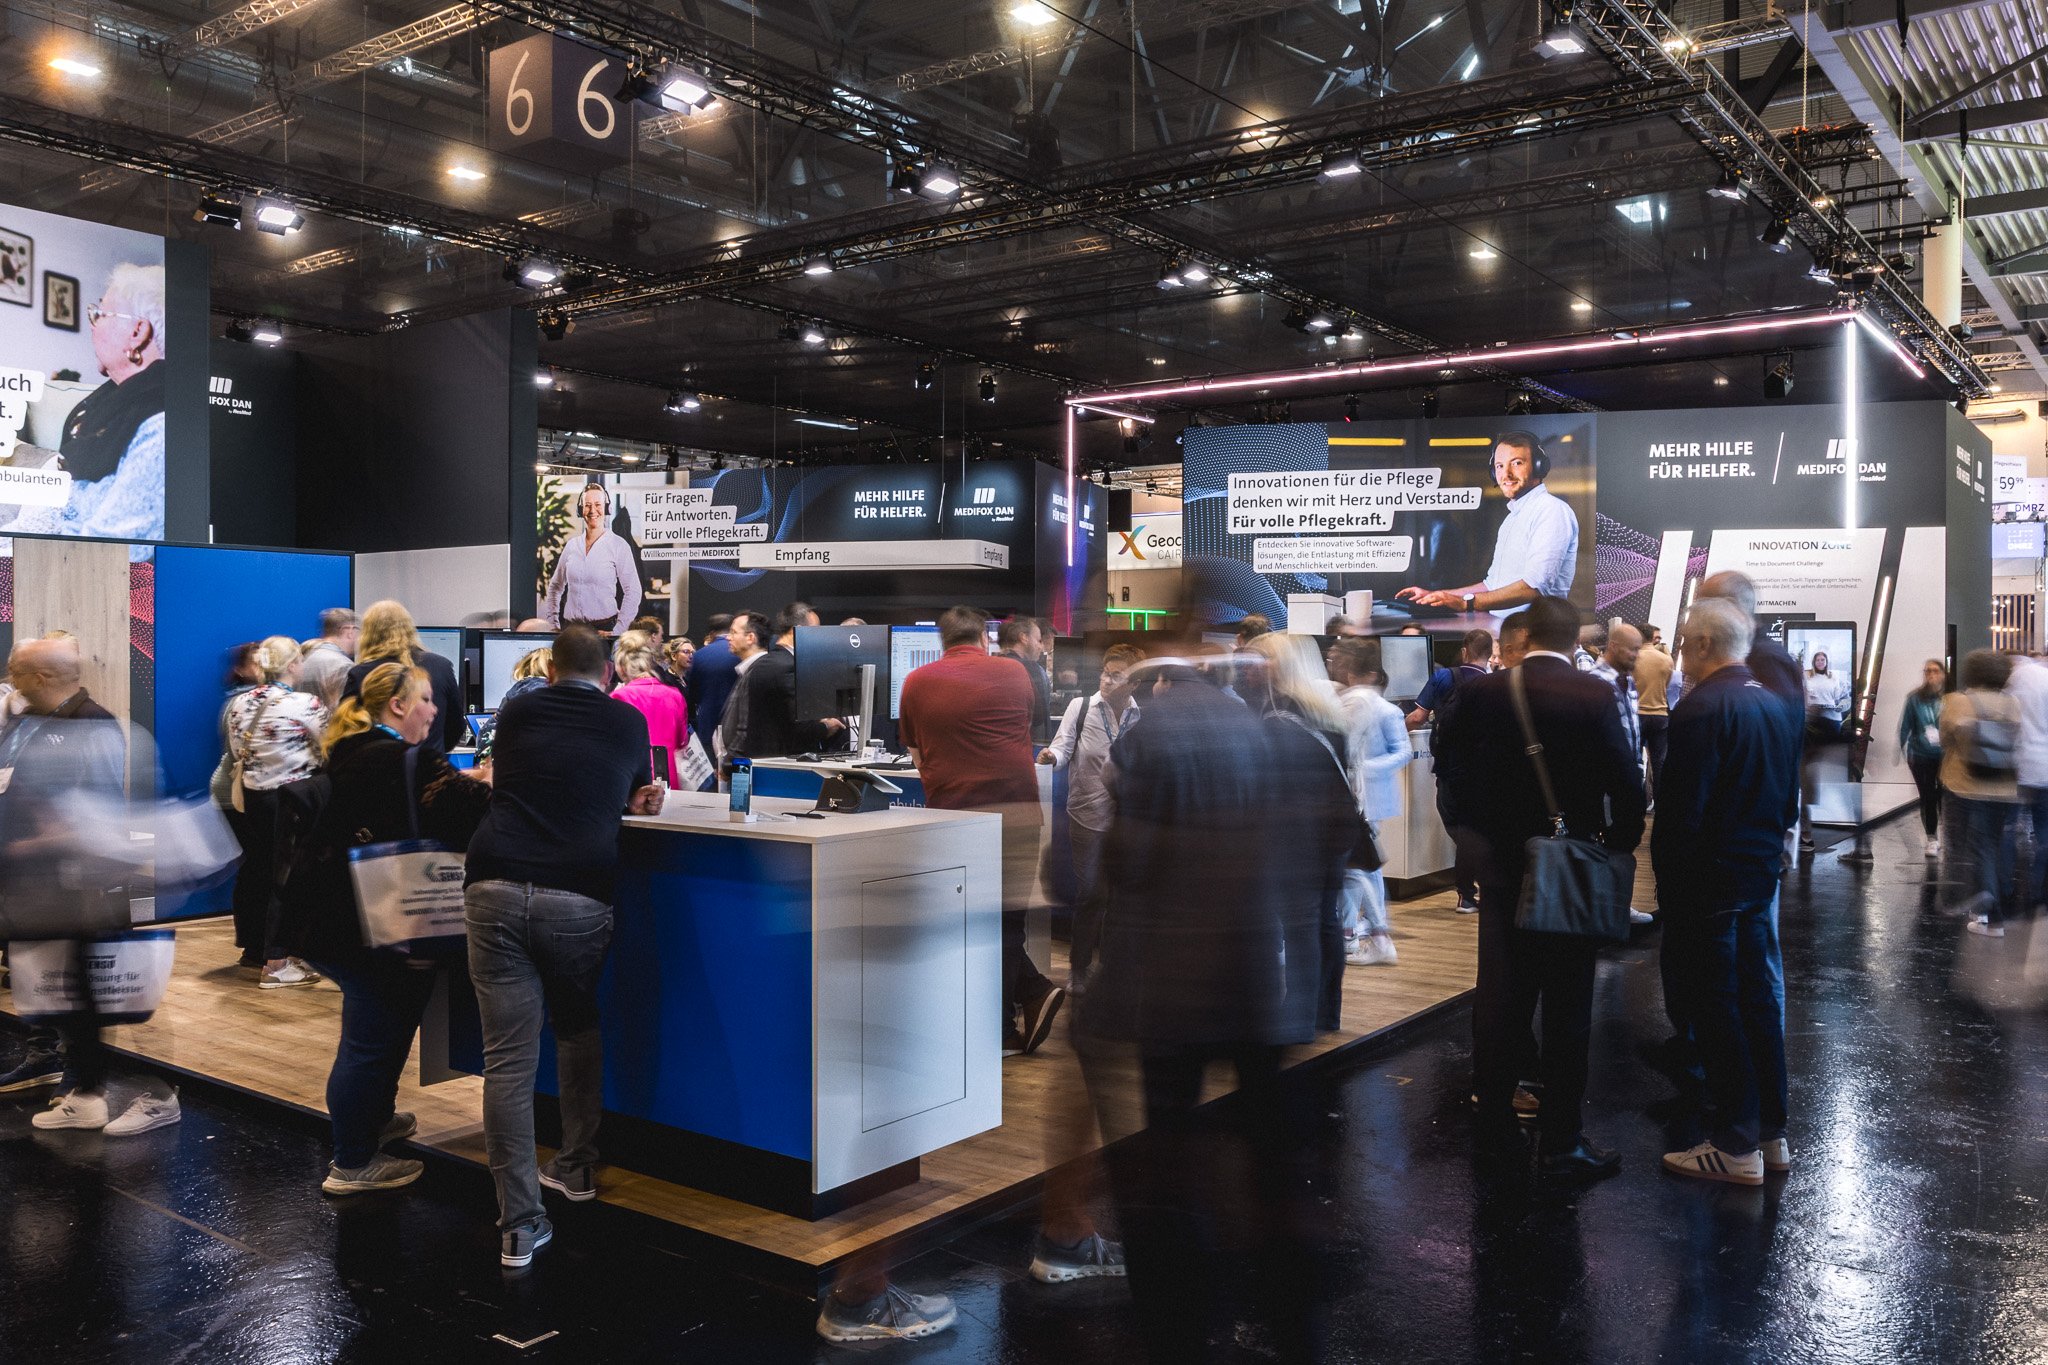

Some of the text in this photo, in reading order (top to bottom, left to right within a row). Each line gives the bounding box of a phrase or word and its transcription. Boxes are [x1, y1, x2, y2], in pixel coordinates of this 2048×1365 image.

[506, 50, 534, 136] 6
[577, 58, 615, 140] 6
[231, 398, 252, 409] DAN
[1649, 441, 1753, 458] MEHR HILFE
[1649, 462, 1756, 479] FÜR HELFER.
[1797, 462, 1887, 475] MEDIFO DAN
[0, 471, 62, 486] bulanten
[1233, 471, 1434, 489] Innovationen für die Pflege
[1999, 476, 2015, 490] 59
[645, 492, 708, 506] Für Fragen.
[854, 489, 925, 502] MEHR HILFE
[1233, 490, 1475, 508] denken wir mit Herz und Verstand:
[854, 505, 927, 518] FÜR HELFER.
[954, 506, 1015, 516] MEDIFOX DAN
[2015, 503, 2045, 512] DMRZ
[645, 510, 731, 522] Für Antworten.
[1233, 512, 1387, 530] Für volle Pflegekraft.
[645, 525, 763, 541] Für volle Pflegekraft.
[1257, 539, 1396, 549] Entdecken Sie innovative Software-
[1748, 541, 1819, 551] INNOVATION
[643, 549, 688, 558] Willkommen
[689, 549, 700, 557] bei
[701, 548, 735, 557] MEDIFOX
[775, 547, 831, 564] Empfang
[1257, 550, 1406, 561] lösungen, die Entlastung mit Effizienz
[1257, 560, 1378, 570] und Menschlichkeit verbinden.
